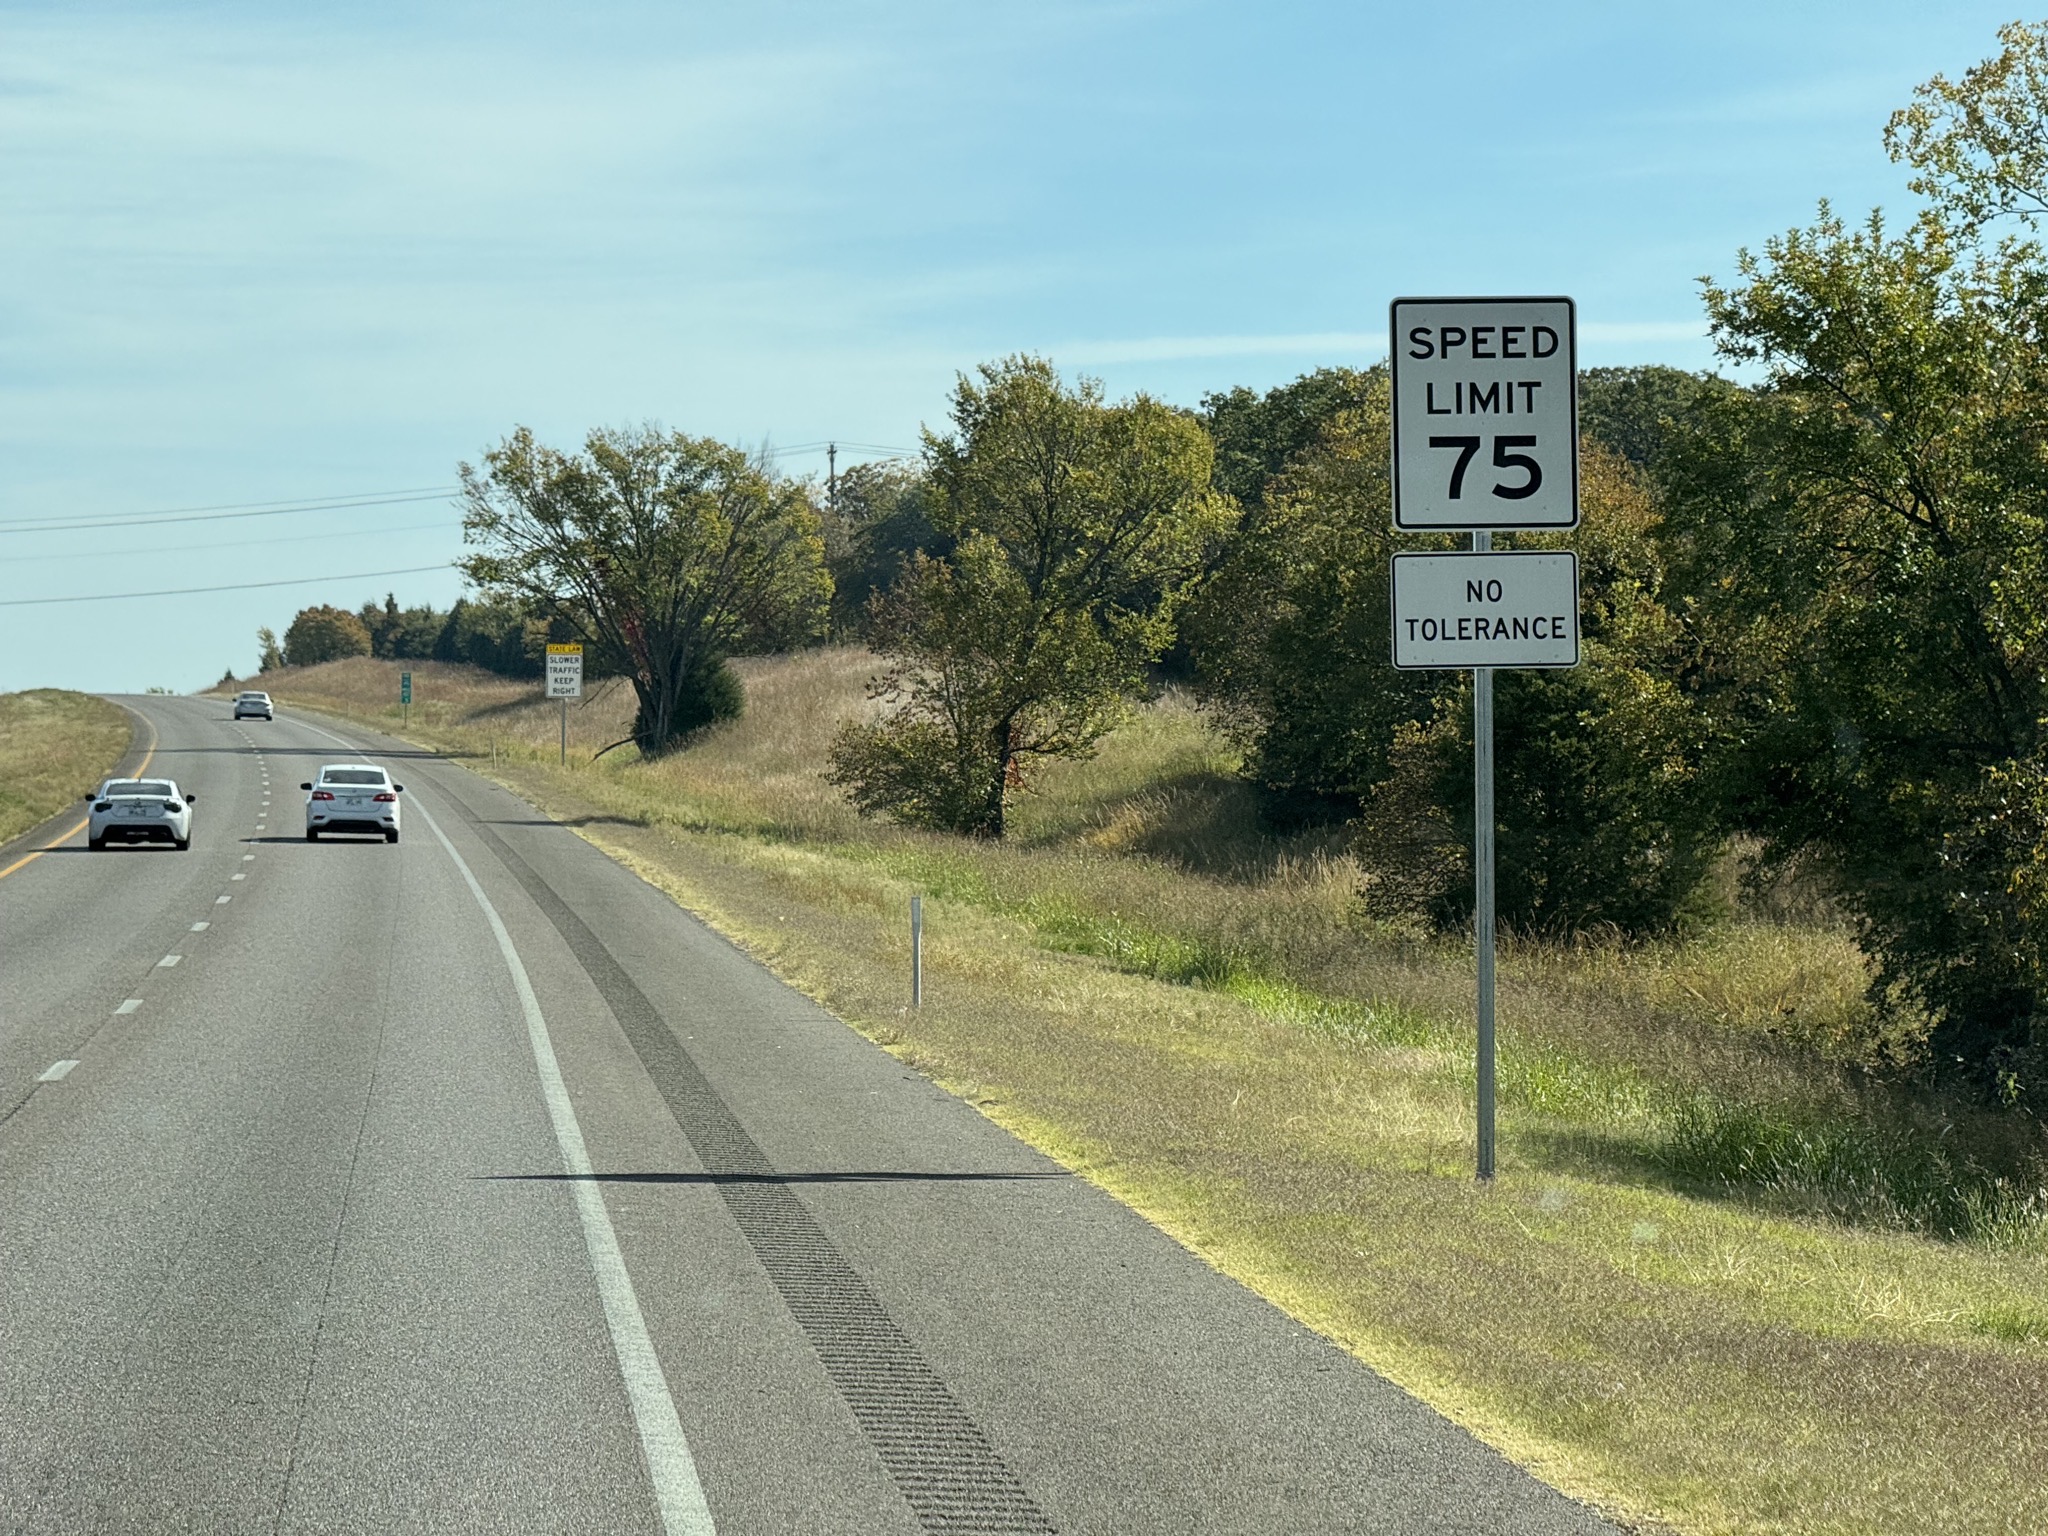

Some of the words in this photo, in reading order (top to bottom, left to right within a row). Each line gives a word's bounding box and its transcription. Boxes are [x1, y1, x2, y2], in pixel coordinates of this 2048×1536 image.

[1408, 326, 1559, 360] SPEED
[1426, 381, 1542, 415] LIMIT
[1428, 435, 1543, 500] 75
[1466, 579, 1503, 603] NO
[1405, 616, 1567, 642] TOLERANCE
[549, 656, 580, 664] SLOWER
[549, 666, 580, 675] TRAFFIC
[552, 687, 575, 695] RIGHT
[554, 677, 574, 685] KEEP
